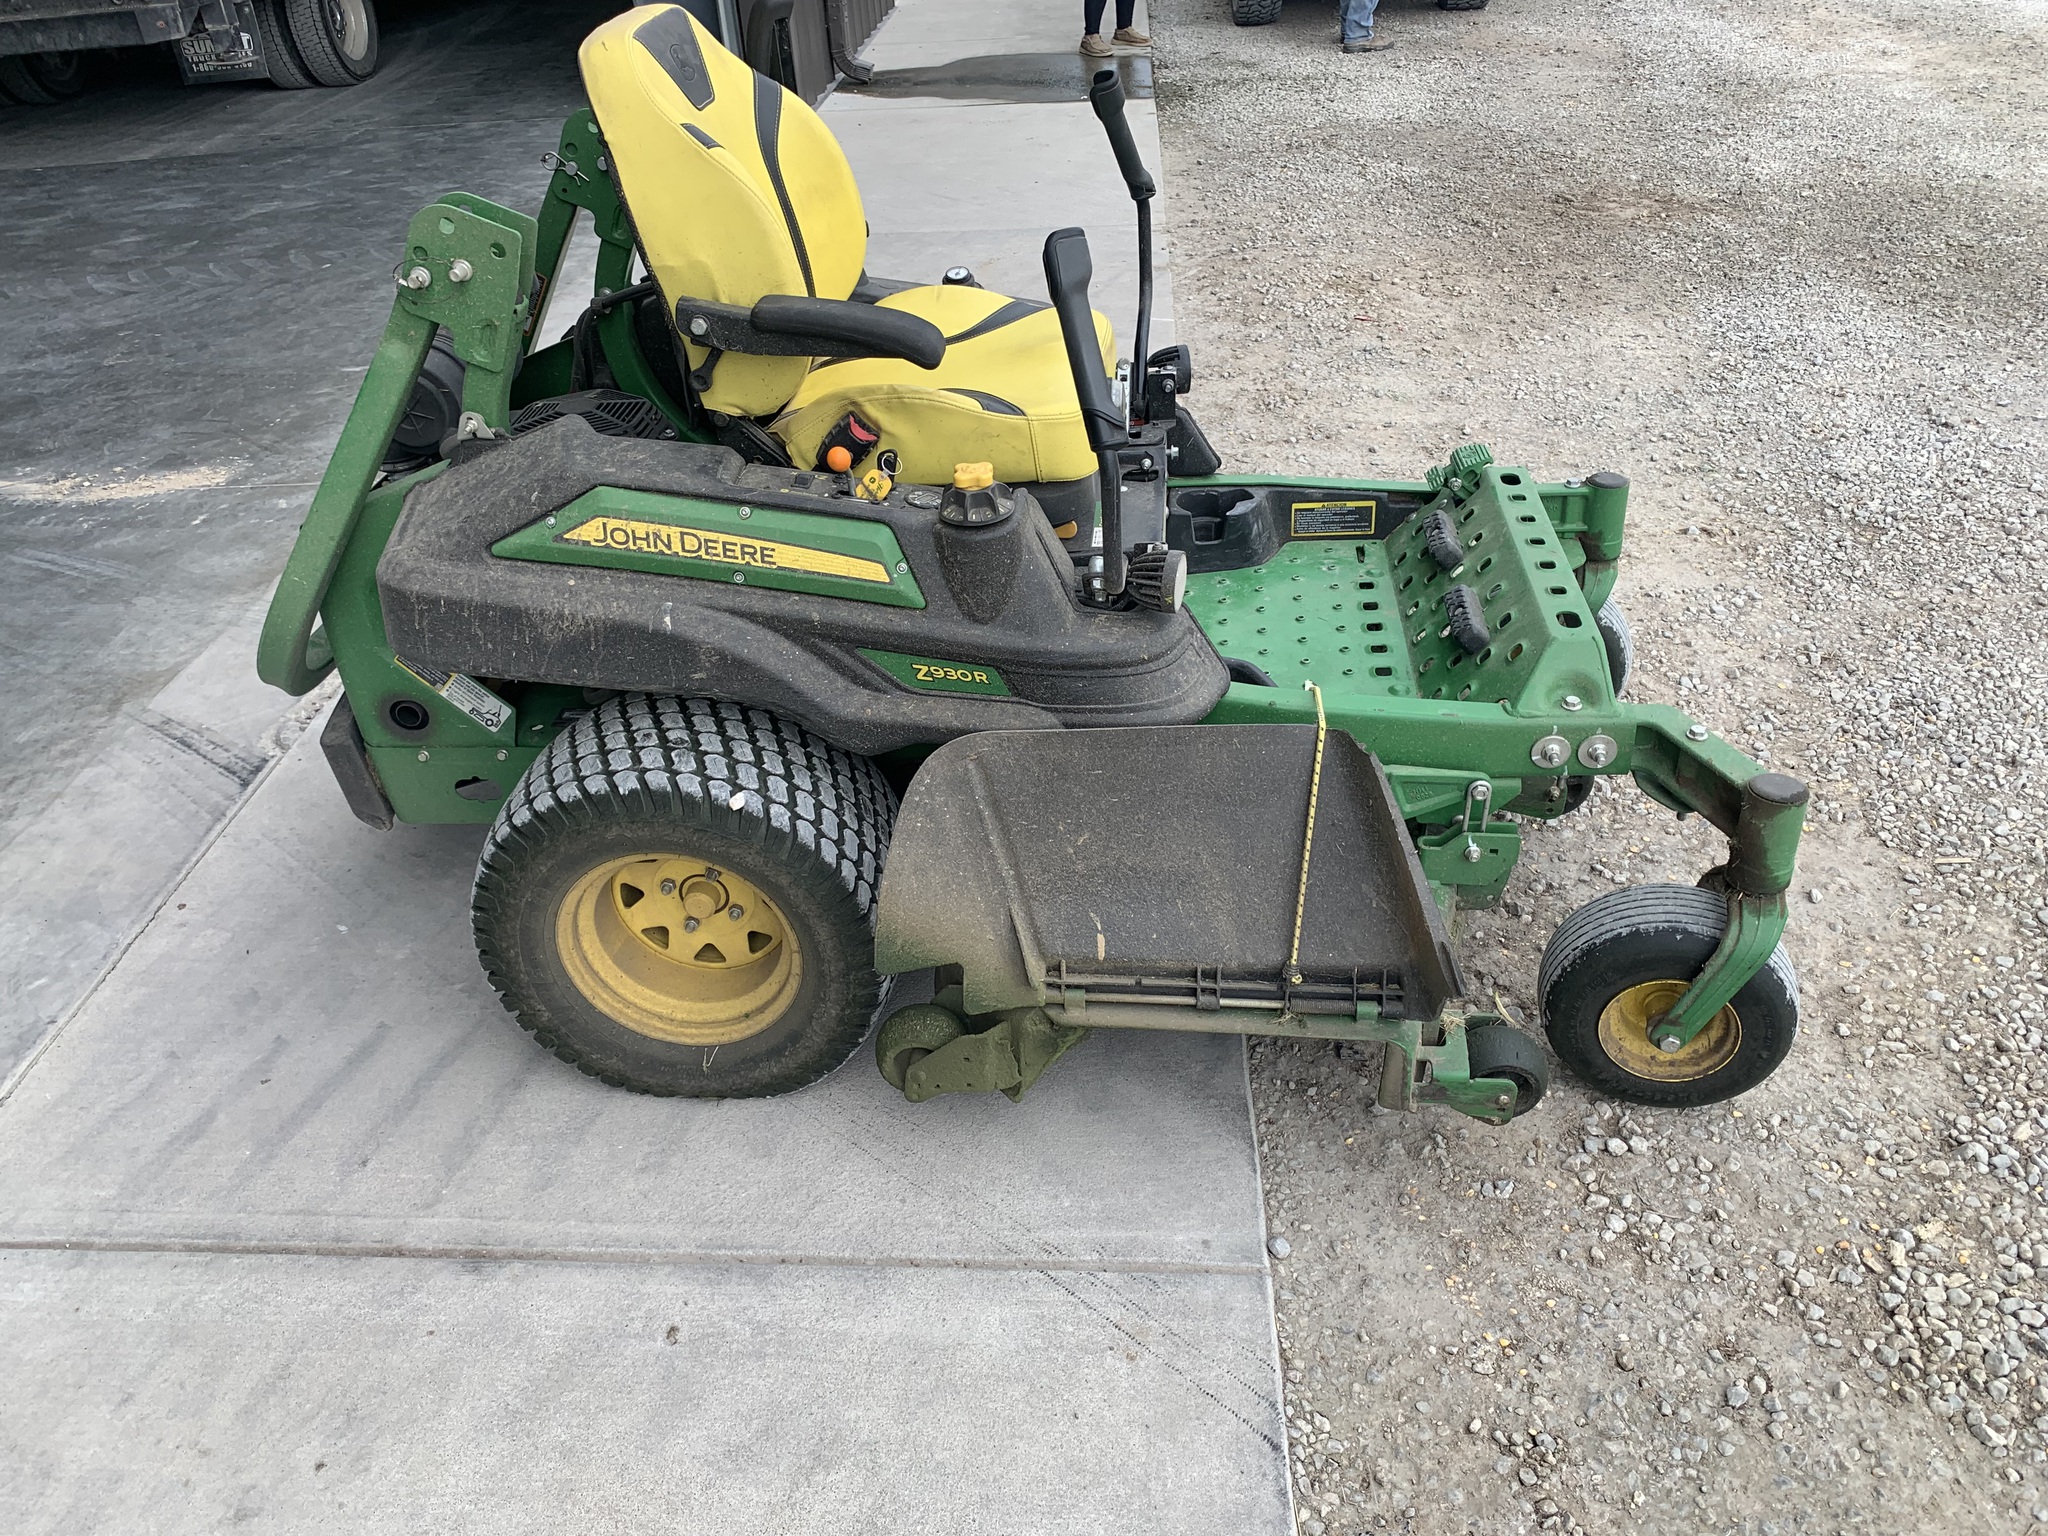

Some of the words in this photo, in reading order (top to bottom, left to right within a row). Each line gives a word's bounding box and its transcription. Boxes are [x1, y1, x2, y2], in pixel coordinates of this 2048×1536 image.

[593, 521, 672, 552] JOHN
[679, 531, 777, 566] DEERE
[912, 664, 990, 684] Z930R
